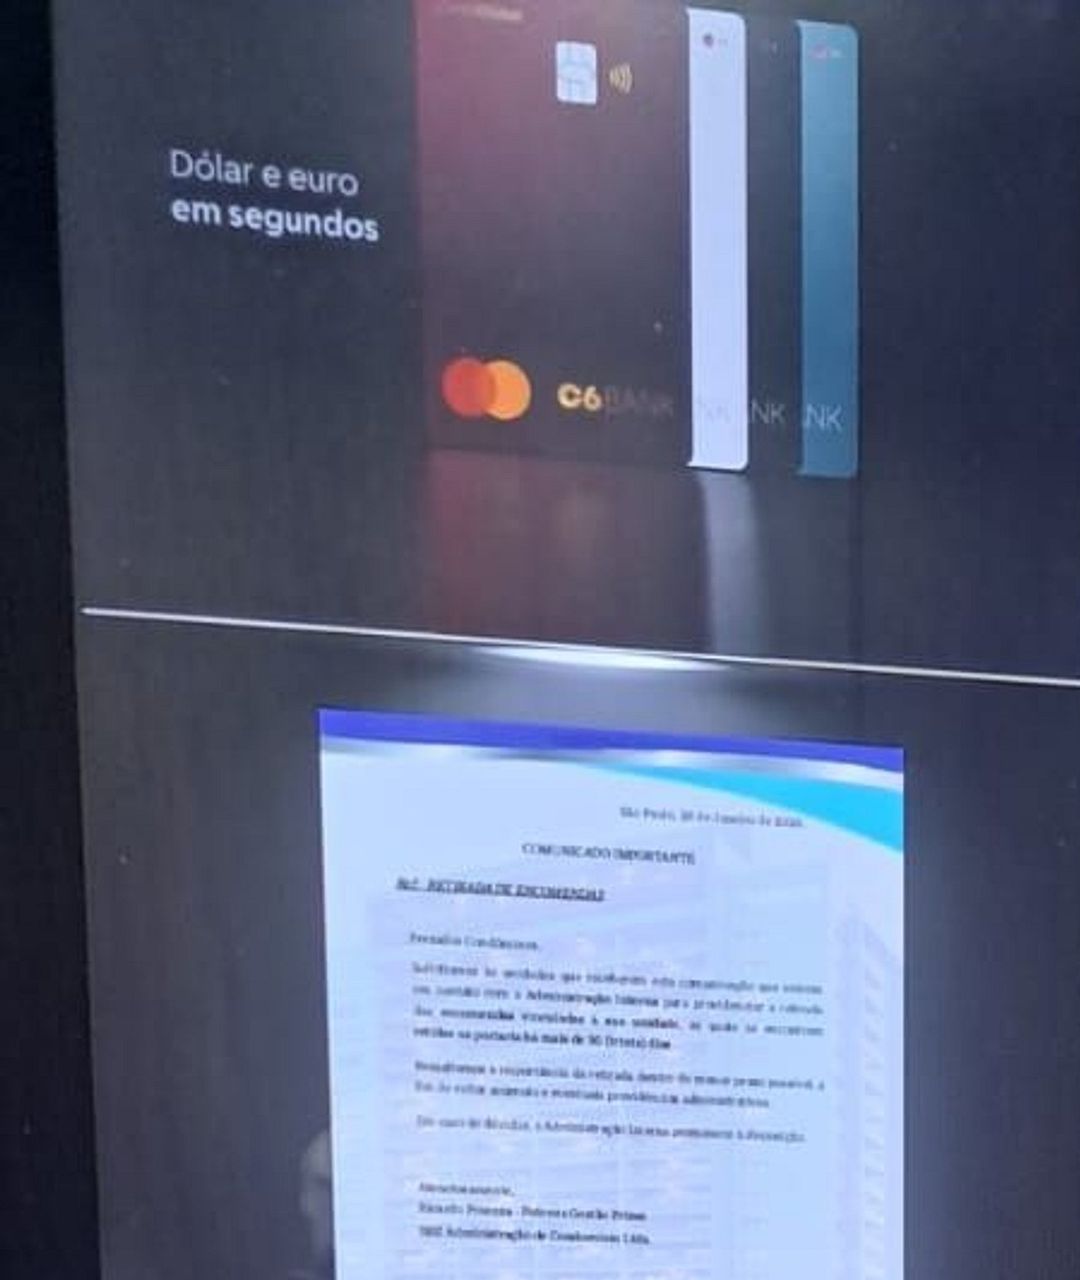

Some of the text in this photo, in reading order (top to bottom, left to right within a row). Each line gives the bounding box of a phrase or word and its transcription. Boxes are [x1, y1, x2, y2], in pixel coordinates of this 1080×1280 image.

[170, 148, 360, 197] Dólar e euro
[171, 199, 380, 242] em segundos
[521, 844, 696, 864] COMUNICADO IMPORTANTE
